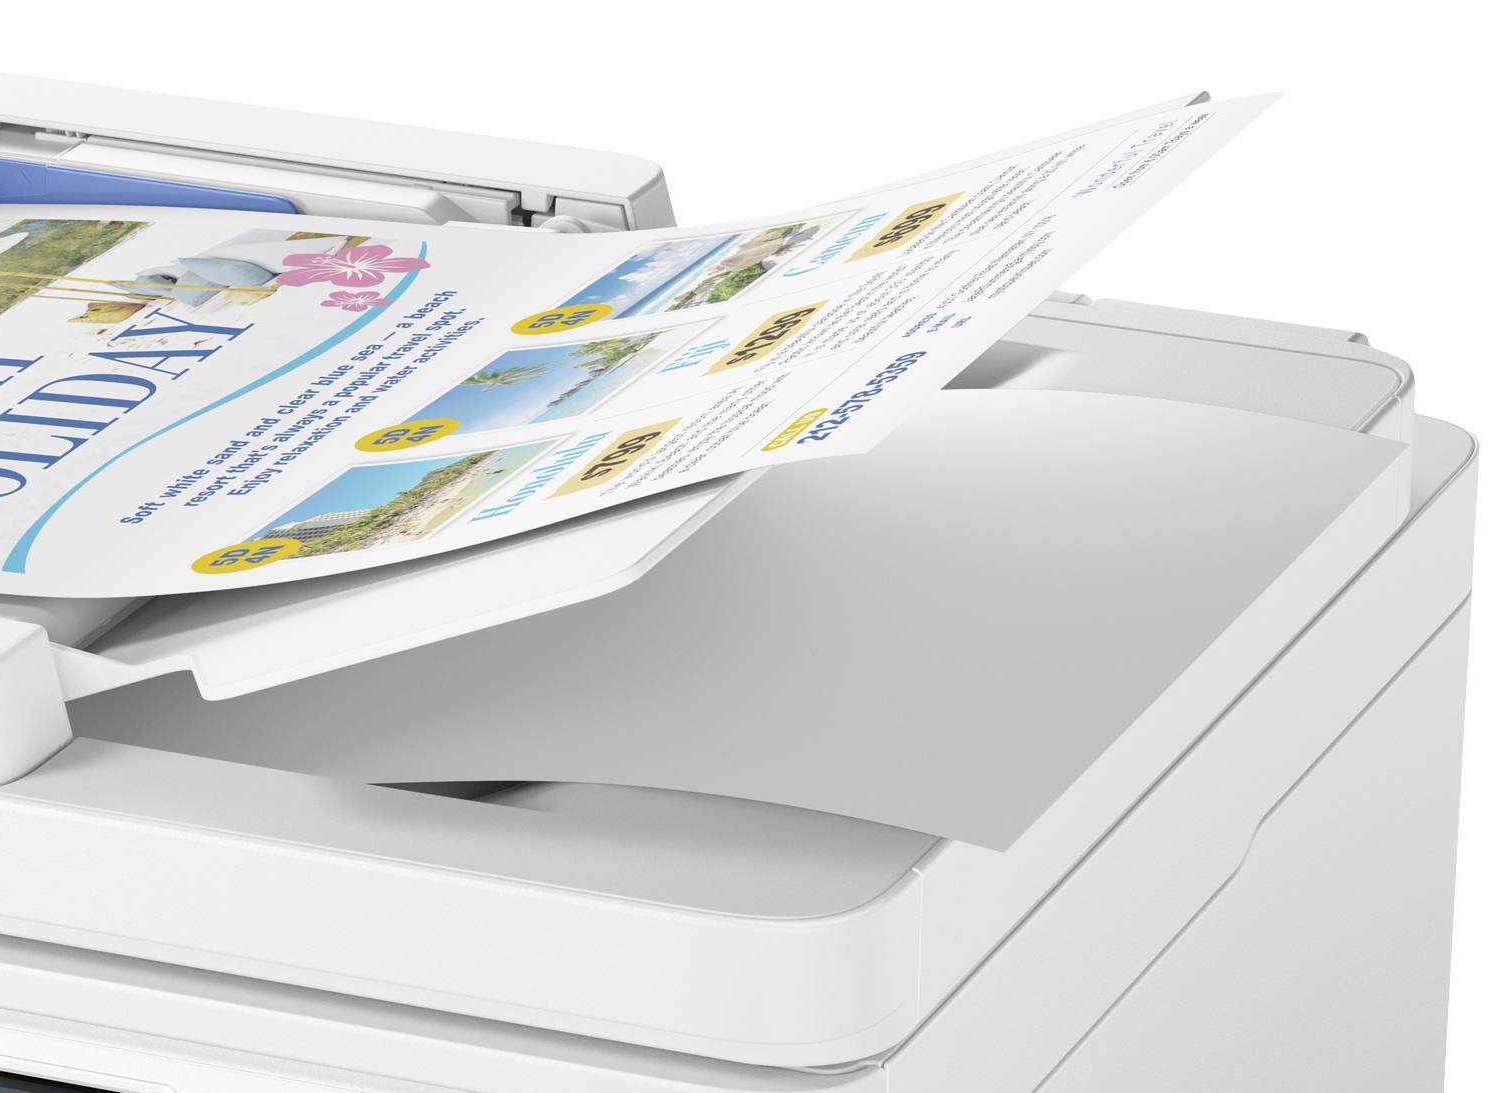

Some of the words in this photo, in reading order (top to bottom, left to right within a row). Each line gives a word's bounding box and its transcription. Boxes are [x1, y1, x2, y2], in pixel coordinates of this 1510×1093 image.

[782, 211, 890, 277] Cancun
[873, 203, 947, 248] $699
[528, 313, 566, 330] 5D
[560, 309, 598, 327] 4N
[725, 307, 816, 366] $1299
[657, 339, 731, 374] Fiji
[120, 501, 166, 524] Soft
[159, 468, 210, 498] white
[206, 440, 250, 466] sand
[246, 417, 281, 437] and
[277, 388, 320, 415] clear
[311, 364, 354, 386] blue
[350, 343, 384, 361] sea
[404, 290, 458, 319] beach
[183, 475, 237, 507] resort
[225, 444, 278, 473] that's
[273, 408, 328, 443] always
[333, 361, 391, 398] popular
[382, 333, 433, 360] travel
[426, 308, 467, 331] spot.
[226, 467, 283, 496] Enjoy
[273, 415, 351, 466] relaxation
[345, 395, 378, 414] and
[371, 365, 418, 393] water
[413, 317, 485, 364] activities.
[372, 428, 411, 446] 5D
[406, 424, 445, 444] 4N
[580, 431, 662, 481] $799
[467, 431, 612, 524] Honolulu
[209, 548, 251, 567] 5D
[244, 544, 286, 564] 4N
